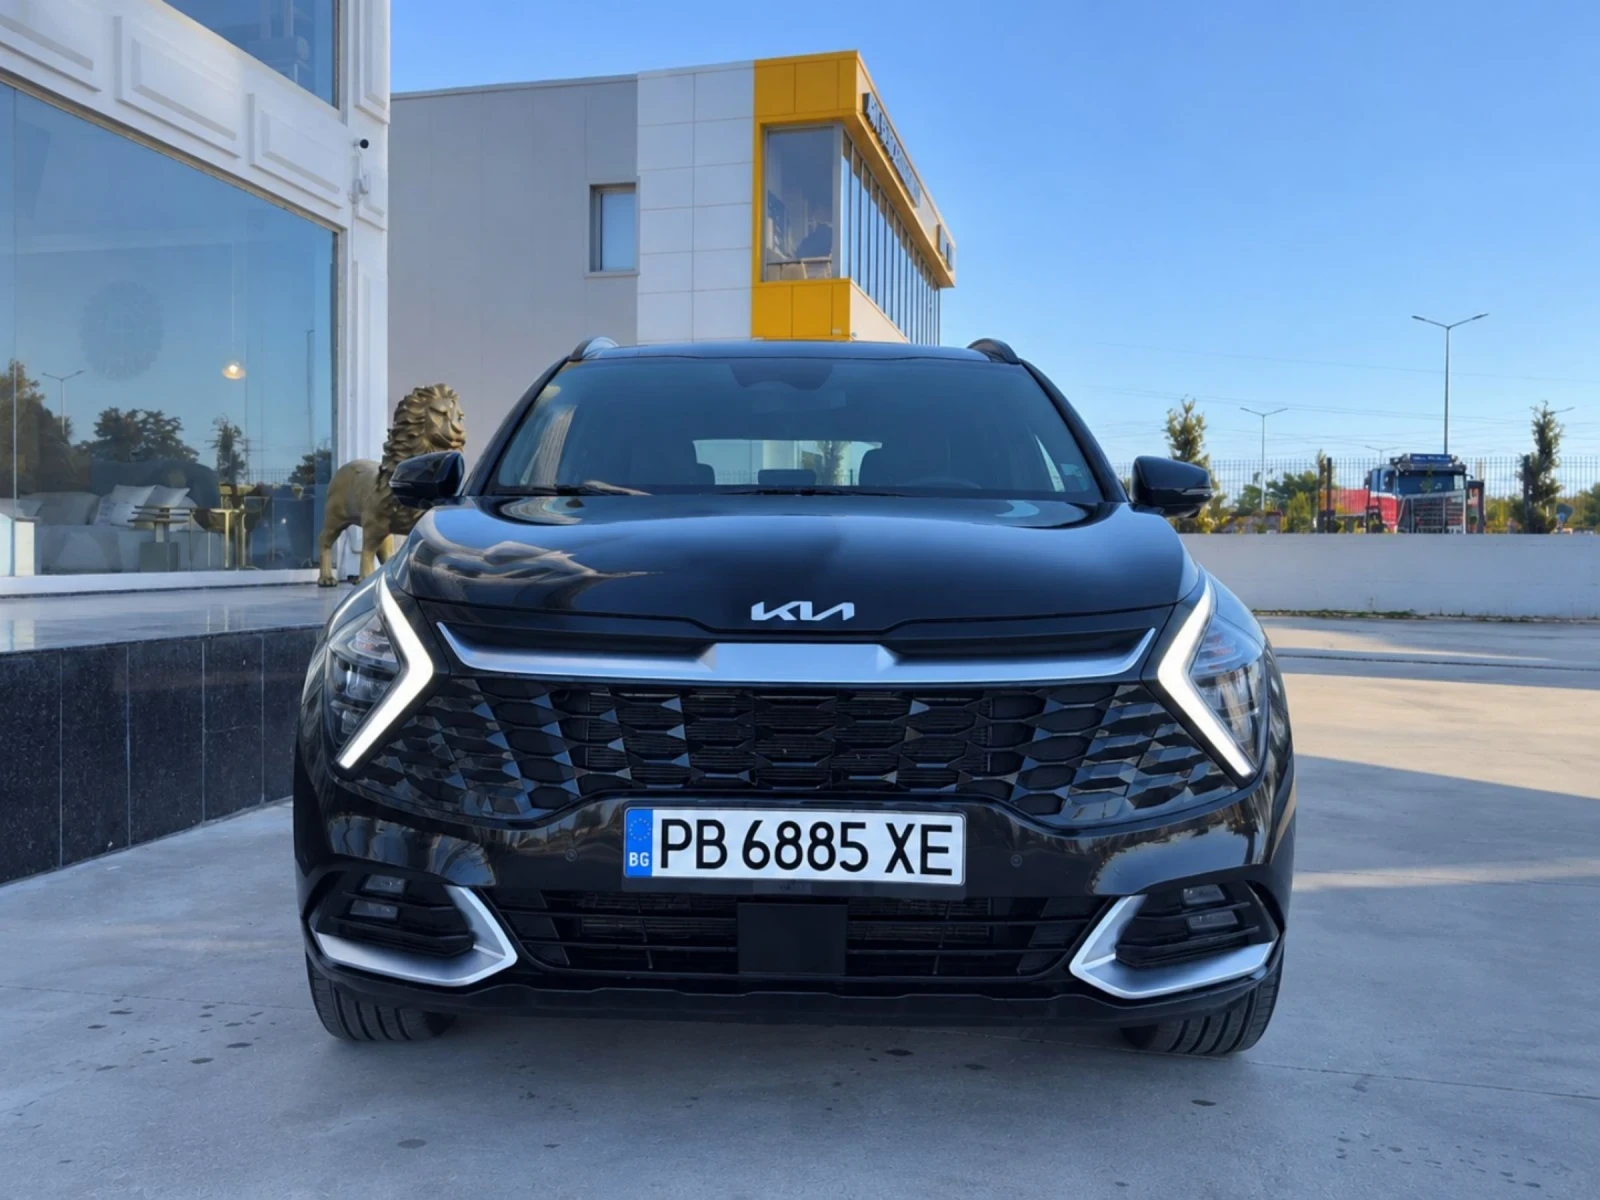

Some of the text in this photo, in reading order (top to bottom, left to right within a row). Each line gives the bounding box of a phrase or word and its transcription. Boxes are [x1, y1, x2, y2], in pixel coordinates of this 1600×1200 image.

[751, 600, 855, 621] KIA
[660, 818, 953, 876] PB 6885 XE
[629, 852, 649, 867] BG
